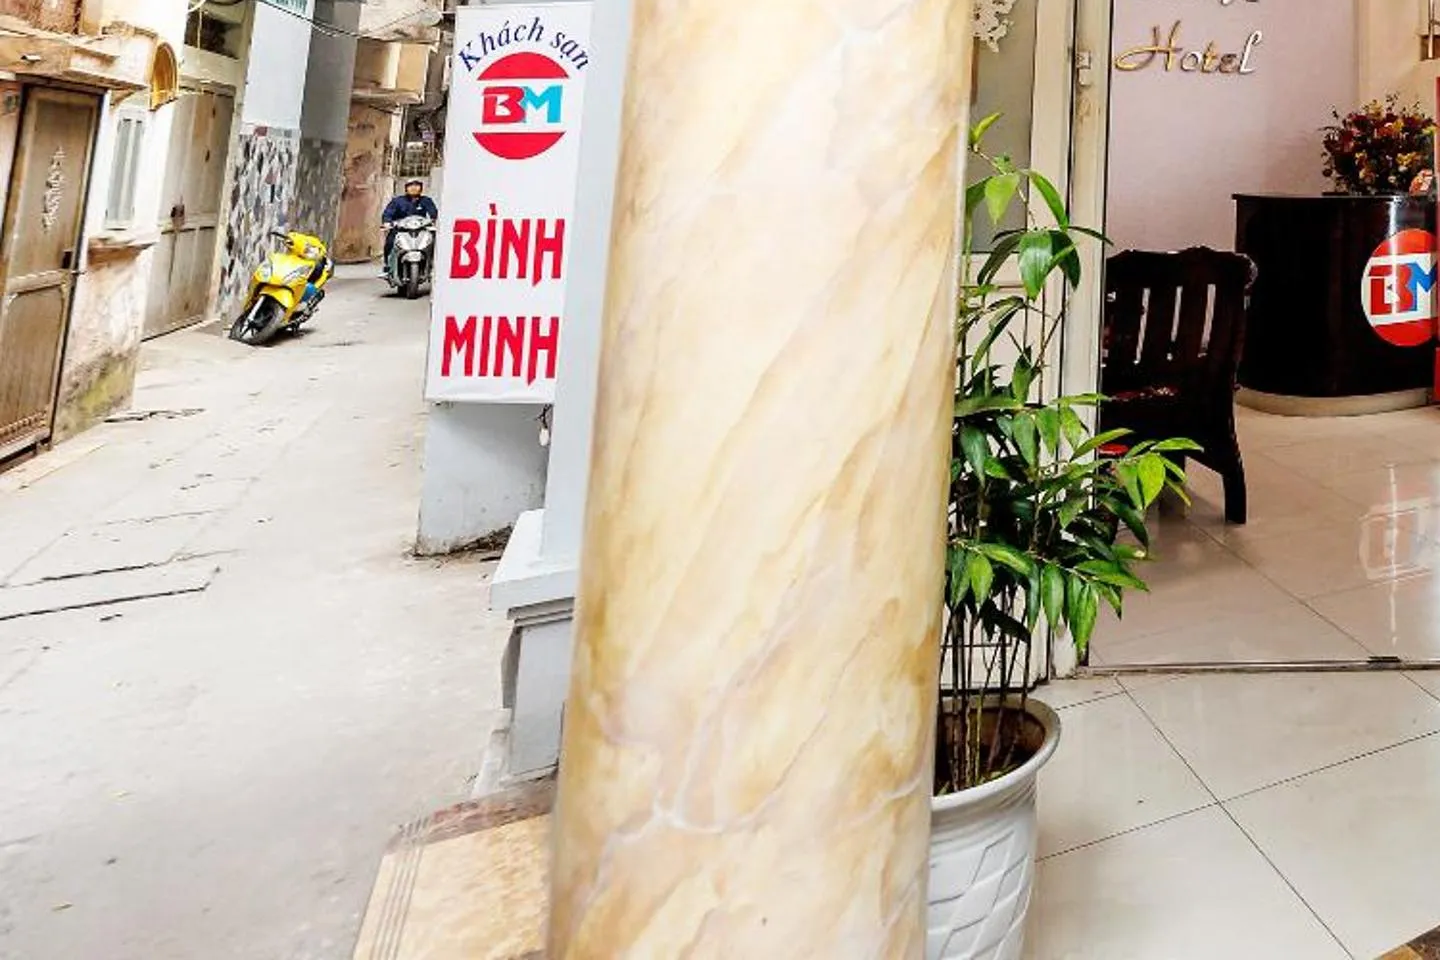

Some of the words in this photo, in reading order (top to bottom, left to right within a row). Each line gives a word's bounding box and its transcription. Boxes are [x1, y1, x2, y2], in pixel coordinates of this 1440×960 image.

[458, 17, 545, 72] Khách
[550, 31, 589, 70] sạn
[1115, 20, 1263, 75] Hotel
[482, 85, 563, 125] BM
[450, 203, 565, 286] BÌNH
[441, 316, 559, 387] MINH
